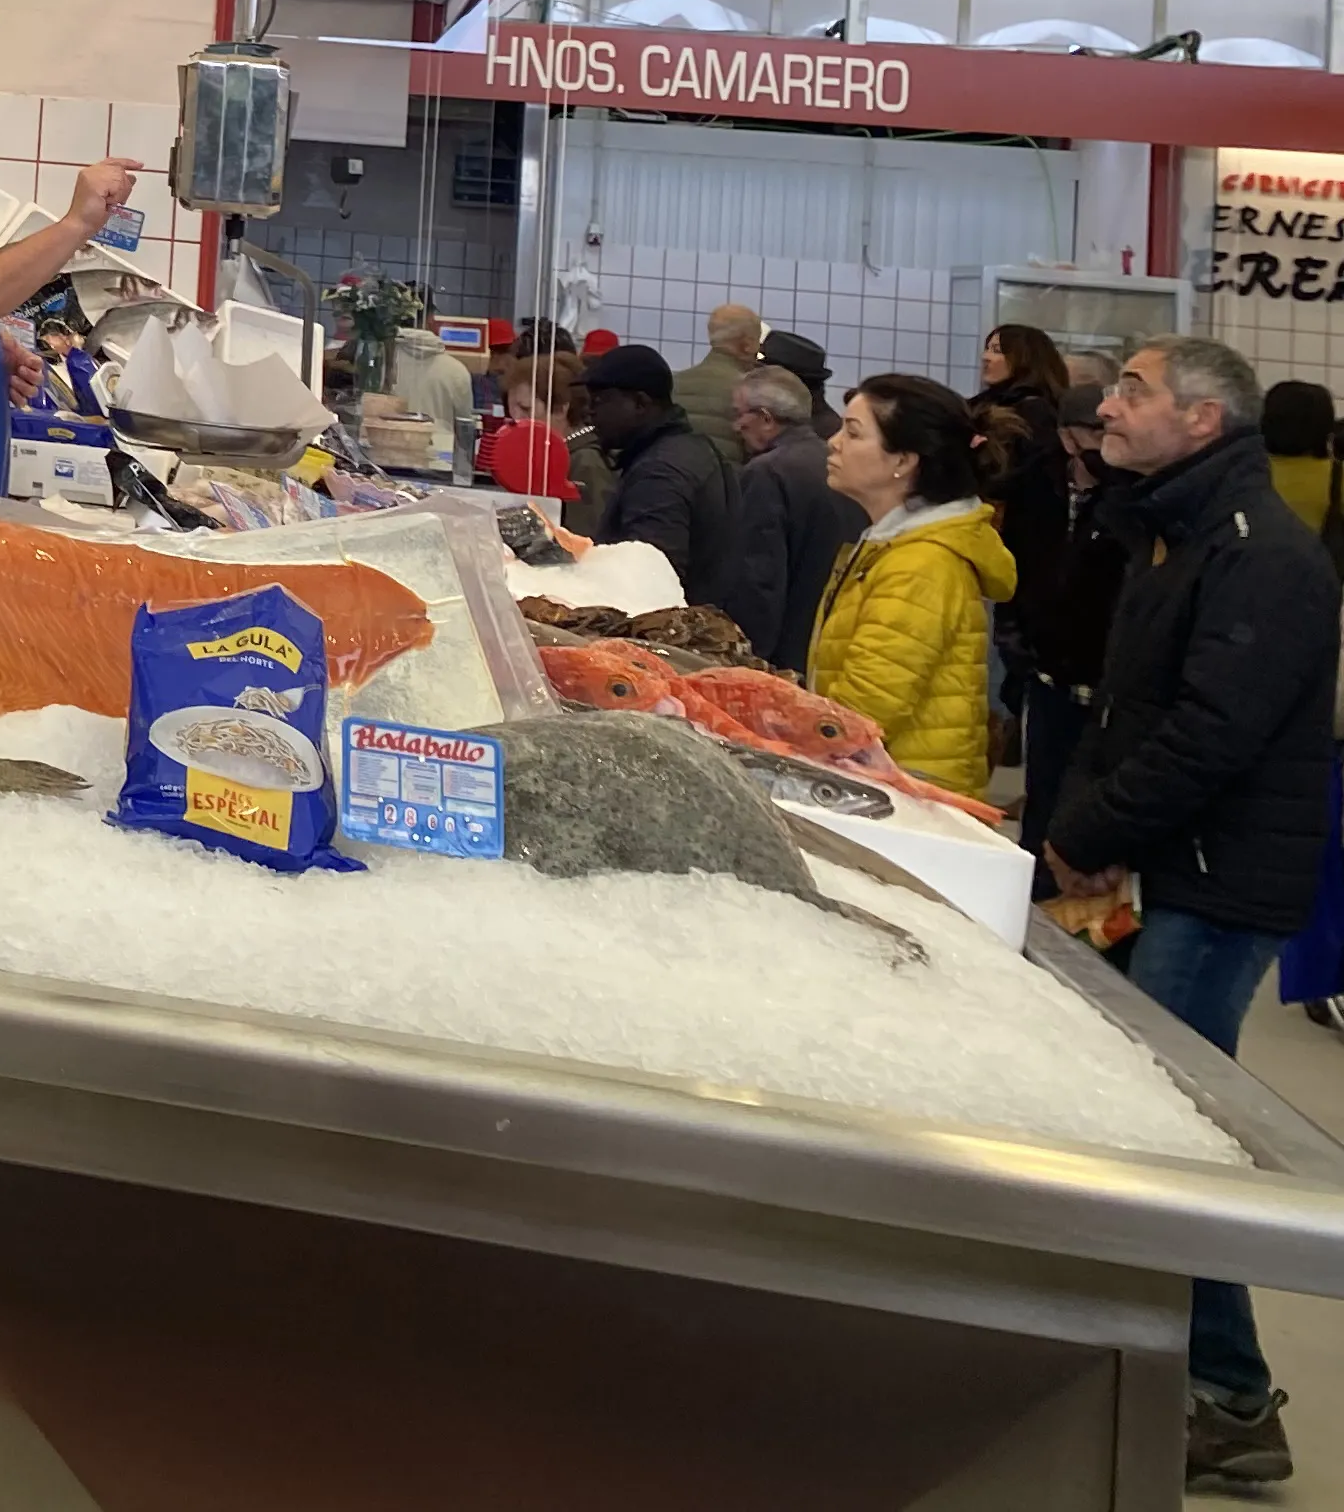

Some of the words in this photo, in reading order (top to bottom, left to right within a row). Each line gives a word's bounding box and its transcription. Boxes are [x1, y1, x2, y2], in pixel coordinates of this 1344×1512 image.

[485, 34, 624, 95] HNOS.
[639, 44, 910, 114] CAMARERO
[202, 644, 230, 655] LA
[236, 632, 288, 660] GULA
[240, 655, 275, 671] NORTE
[192, 792, 280, 832] ESPECIAL
